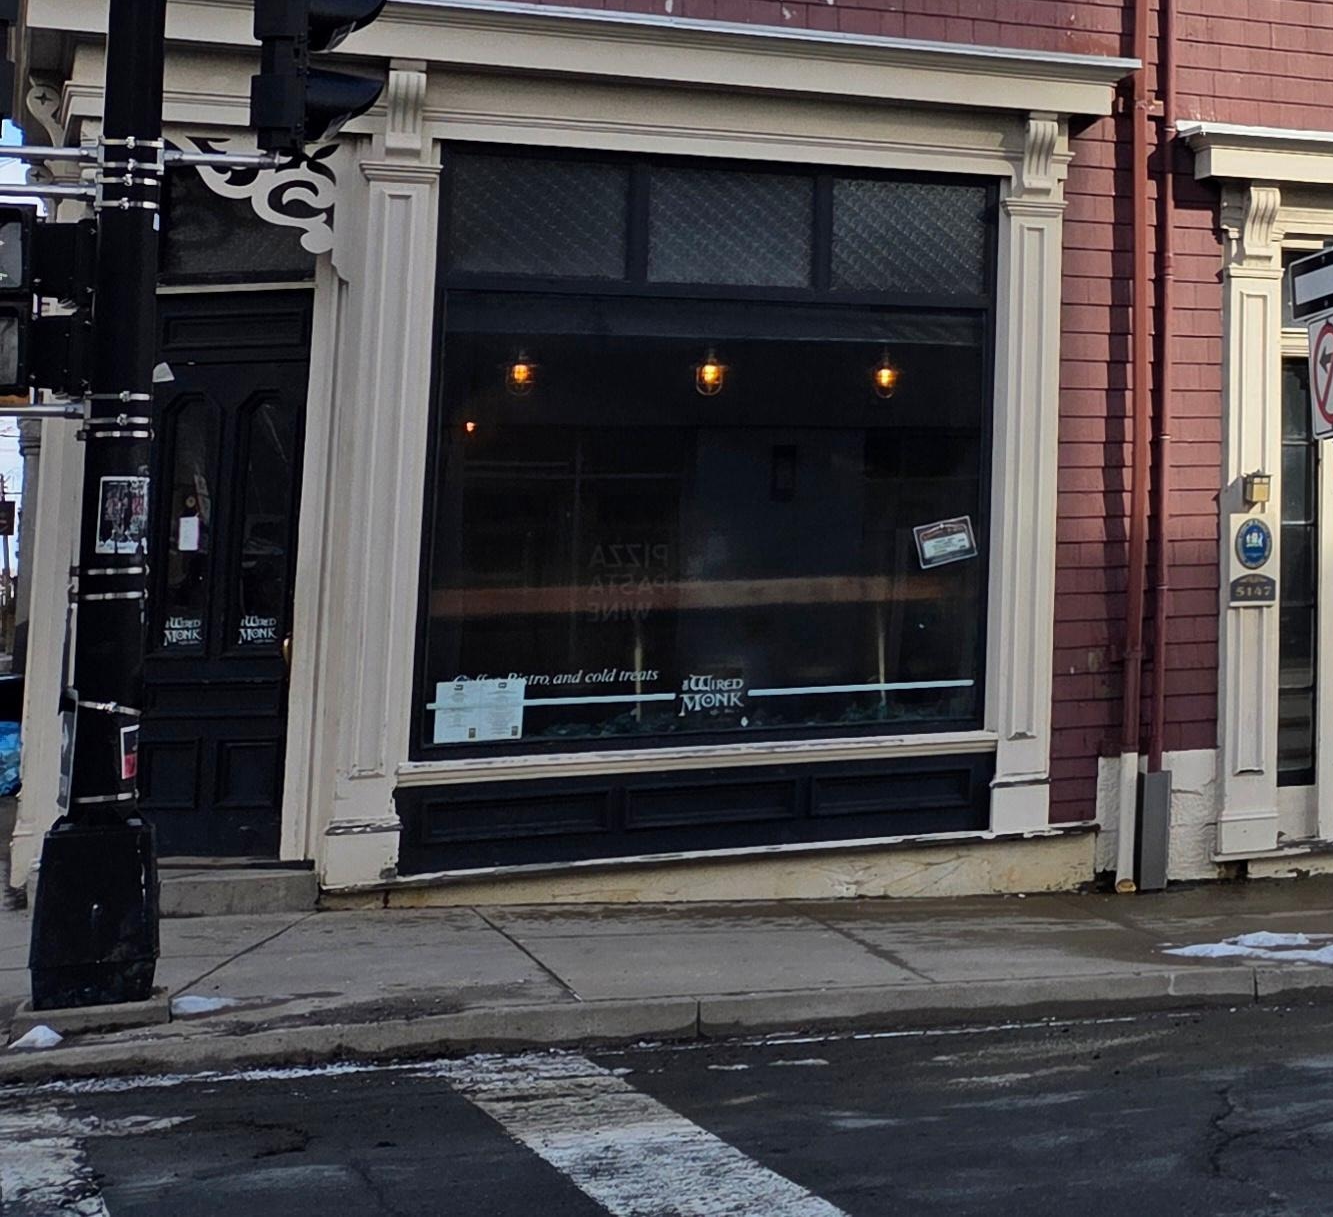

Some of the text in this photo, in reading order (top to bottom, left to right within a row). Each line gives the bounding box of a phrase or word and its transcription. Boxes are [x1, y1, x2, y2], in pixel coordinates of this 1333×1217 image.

[1235, 585, 1272, 598] 5147
[163, 629, 203, 646] MONK
[238, 628, 278, 644] MONK
[552, 669, 583, 684] and
[585, 668, 617, 683] cold
[619, 669, 659, 682] treats
[689, 674, 744, 691] WIRED
[678, 692, 745, 717] MONK
